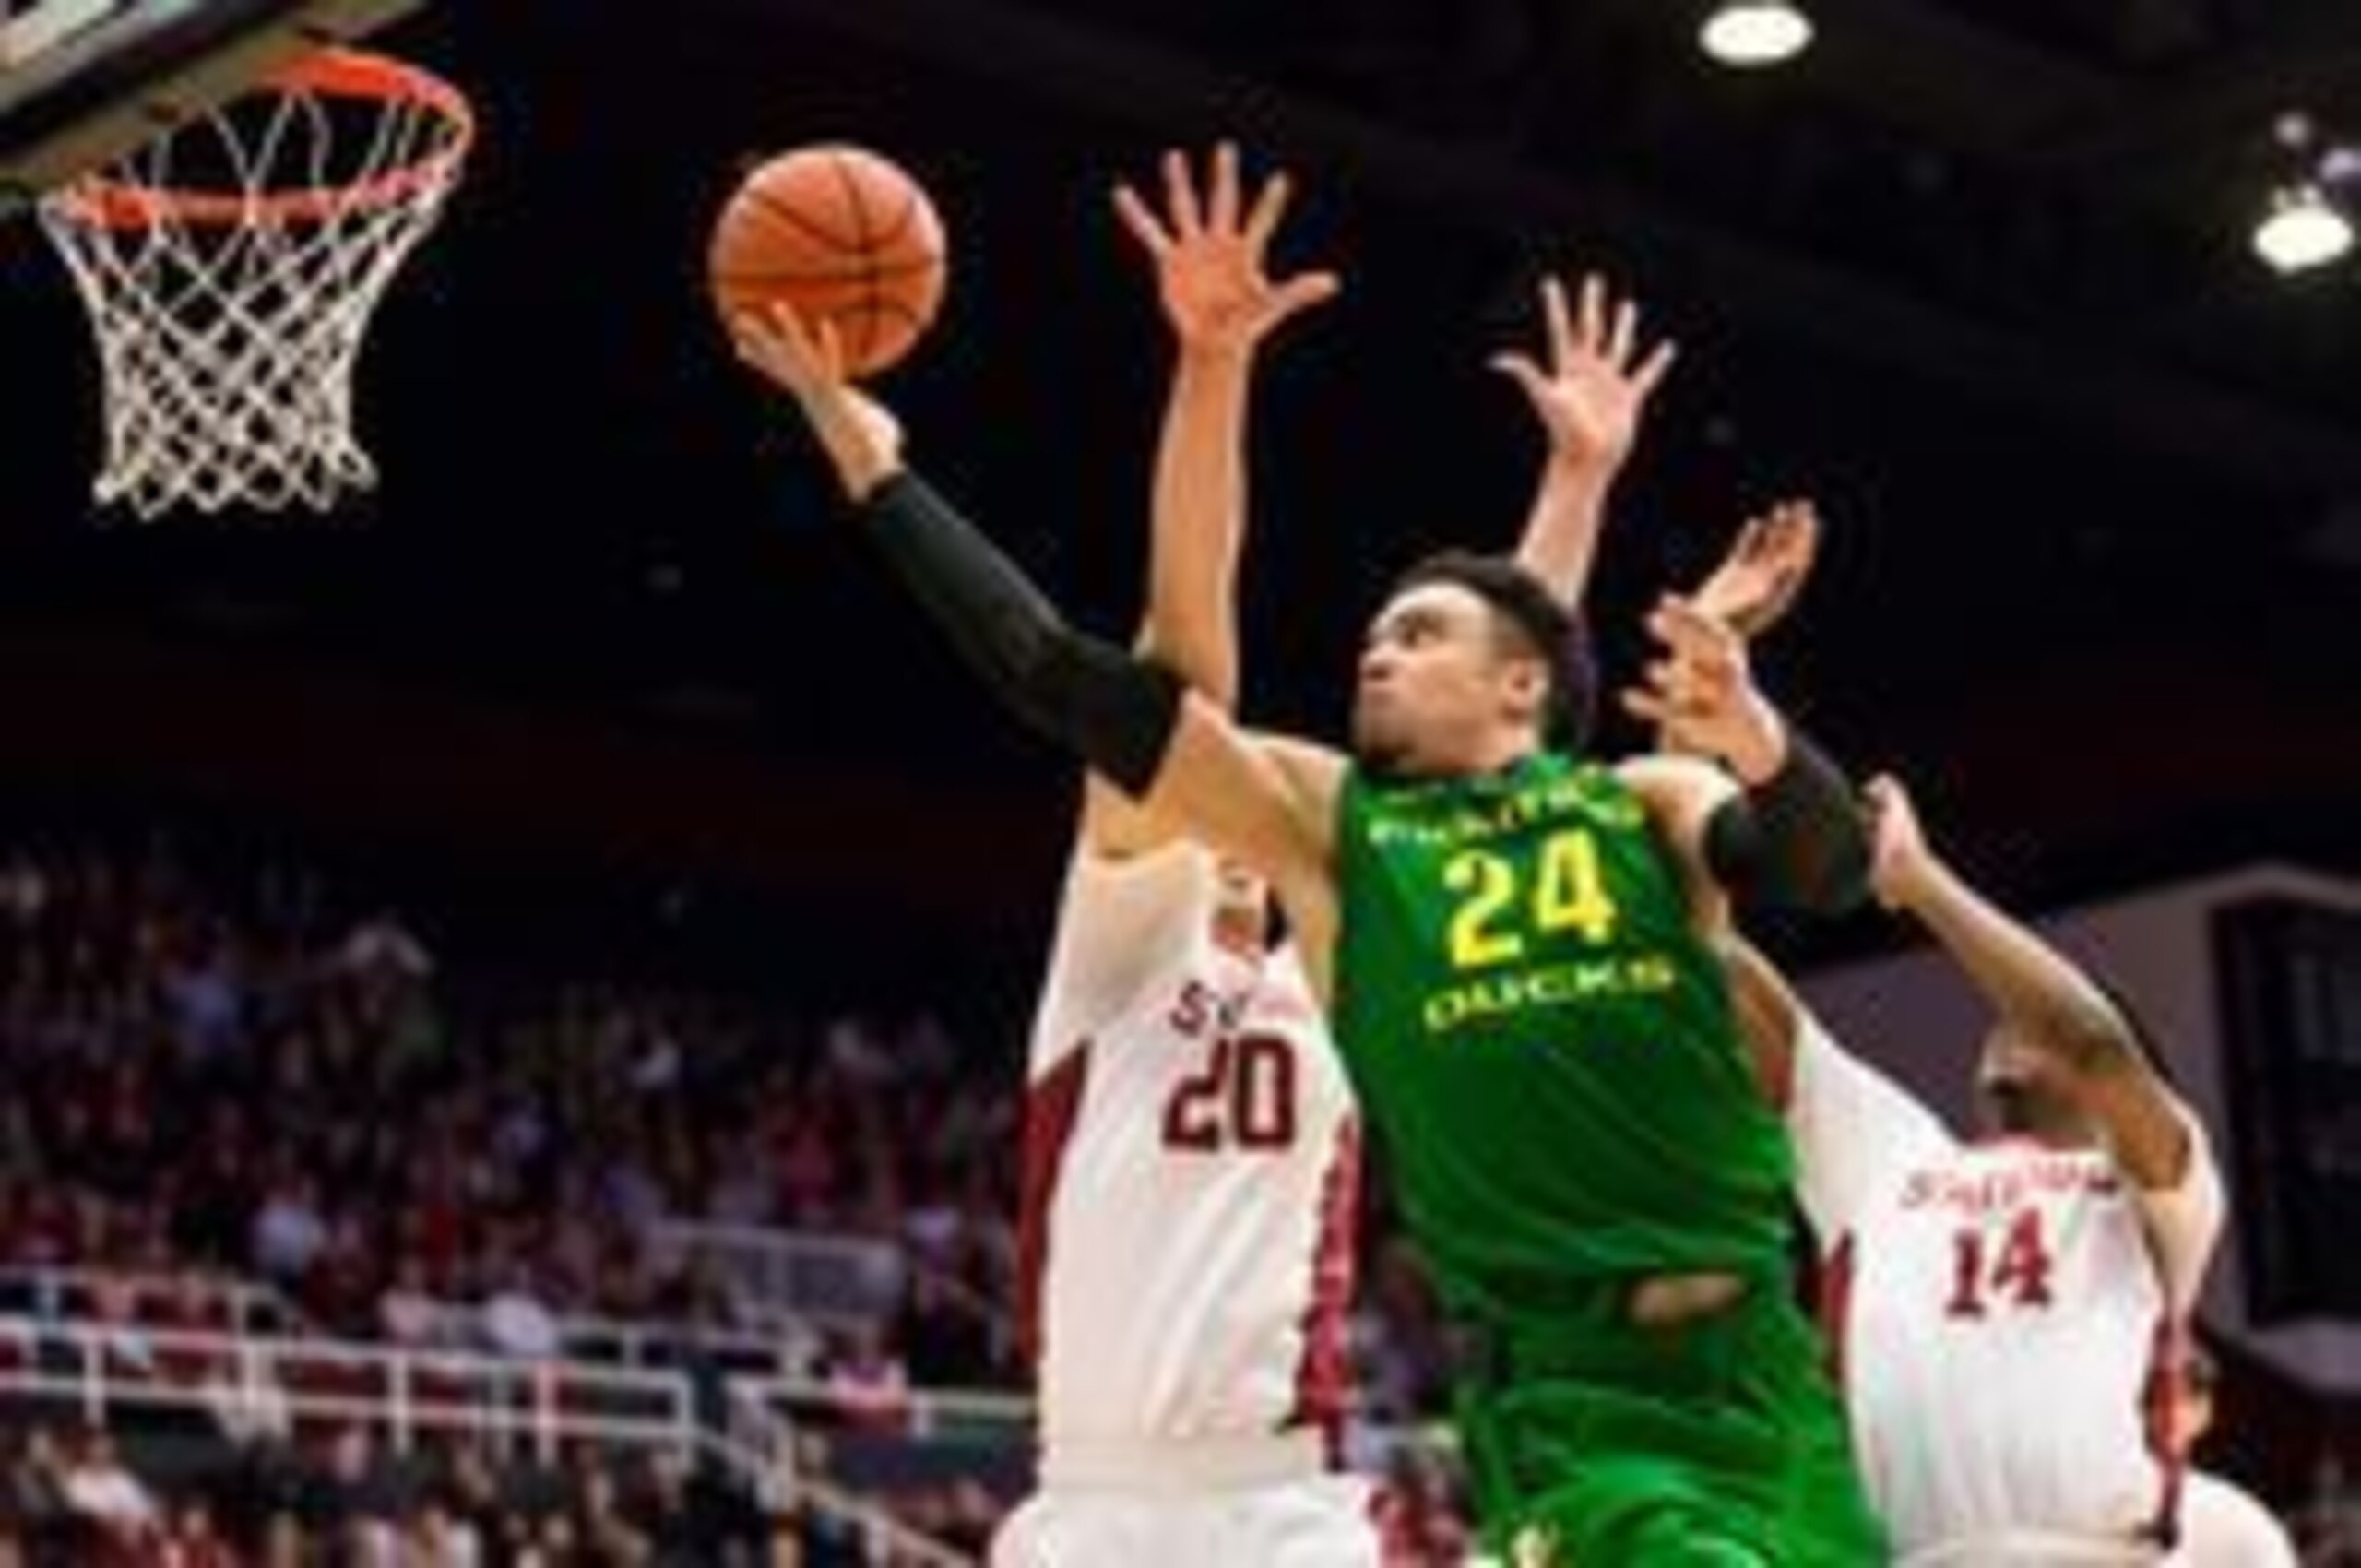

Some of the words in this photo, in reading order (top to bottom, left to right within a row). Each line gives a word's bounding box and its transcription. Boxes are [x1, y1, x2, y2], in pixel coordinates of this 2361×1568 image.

[1442, 828, 1617, 967] 24
[1423, 954, 1676, 1030] DUCKS
[1162, 1034, 1296, 1153] 20
[1943, 1206, 2053, 1321] 14
